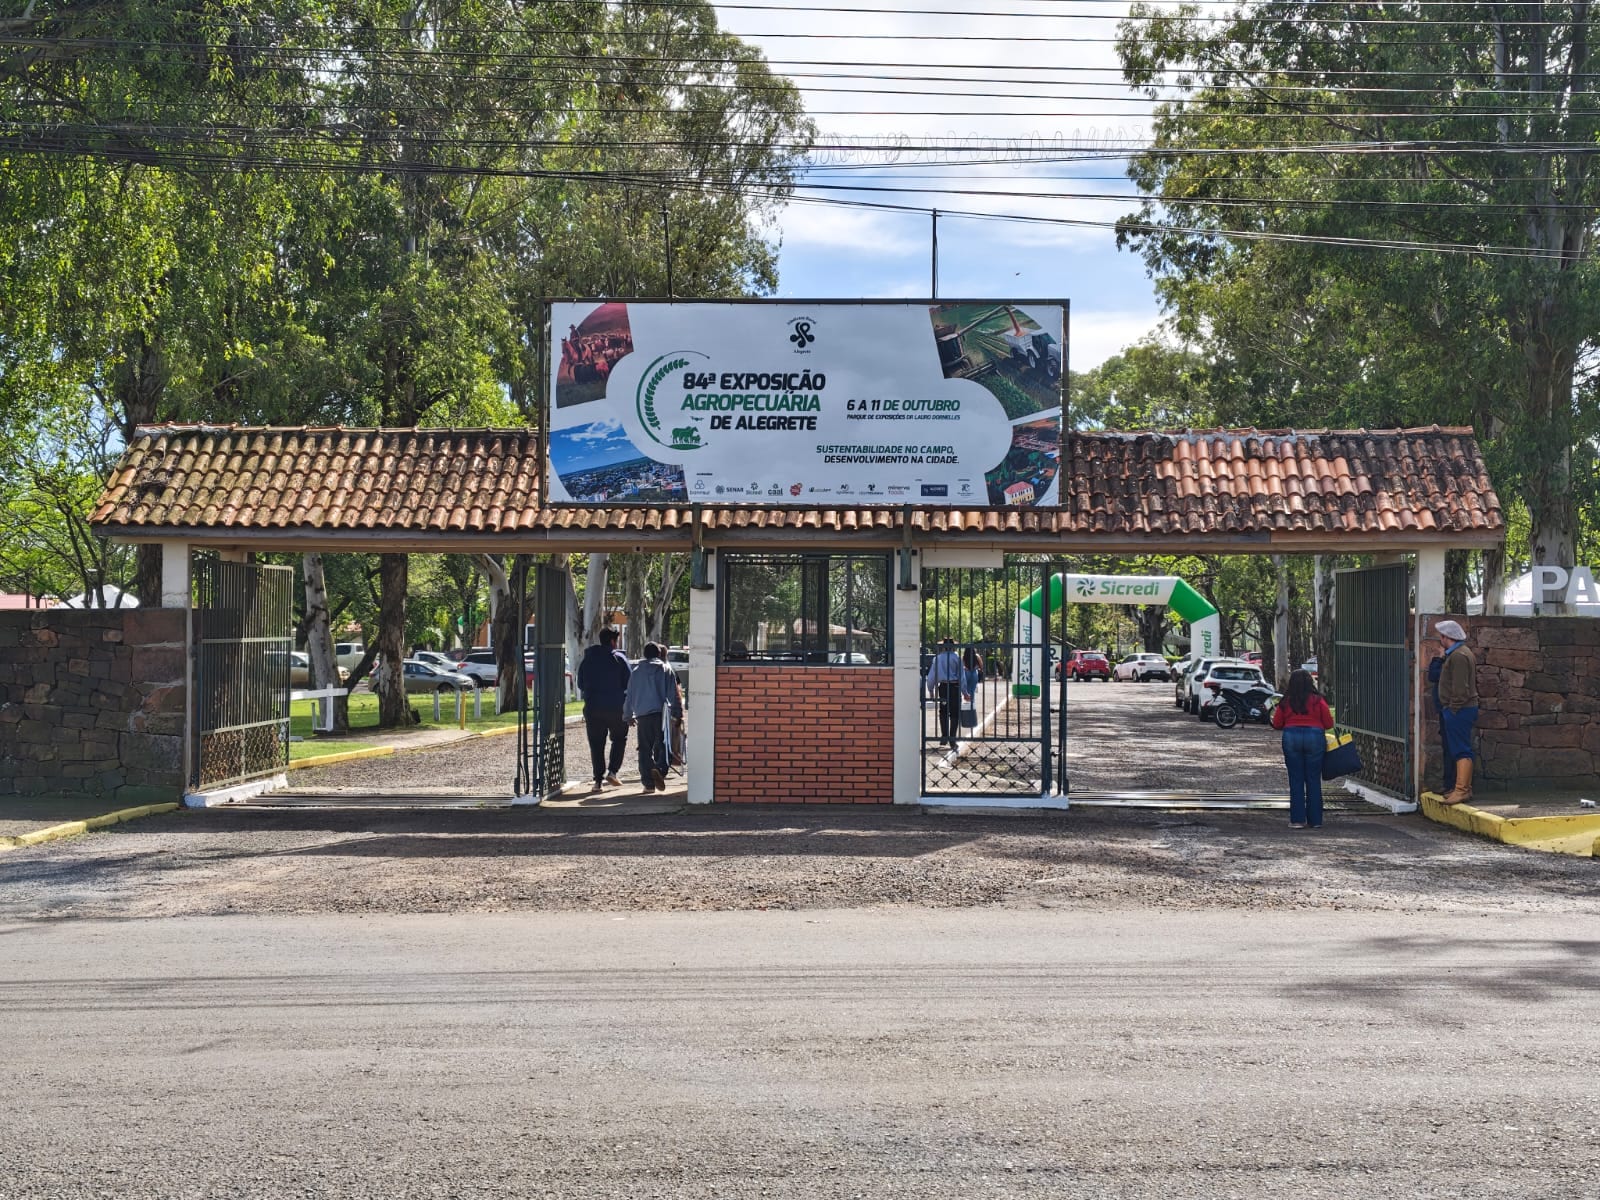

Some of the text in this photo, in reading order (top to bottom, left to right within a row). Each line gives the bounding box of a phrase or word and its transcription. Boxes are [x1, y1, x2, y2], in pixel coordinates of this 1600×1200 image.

[683, 370, 826, 393] 84ª EXPOSIÇÃO
[681, 391, 821, 411] AGROPECUÁRIA
[847, 400, 960, 411] 6 A 11 DE OUTUBRO
[710, 415, 817, 431] DE ALEGRETE
[875, 413, 905, 421] EXPOSIÇÕES
[816, 445, 955, 455] SUSTENTABILIDADE NO CAMPO,
[824, 455, 959, 464] DESENVOLVIMENTO NA CIDADE.
[1100, 581, 1160, 596] Sicredi
[1022, 625, 1032, 665] Sicedi
